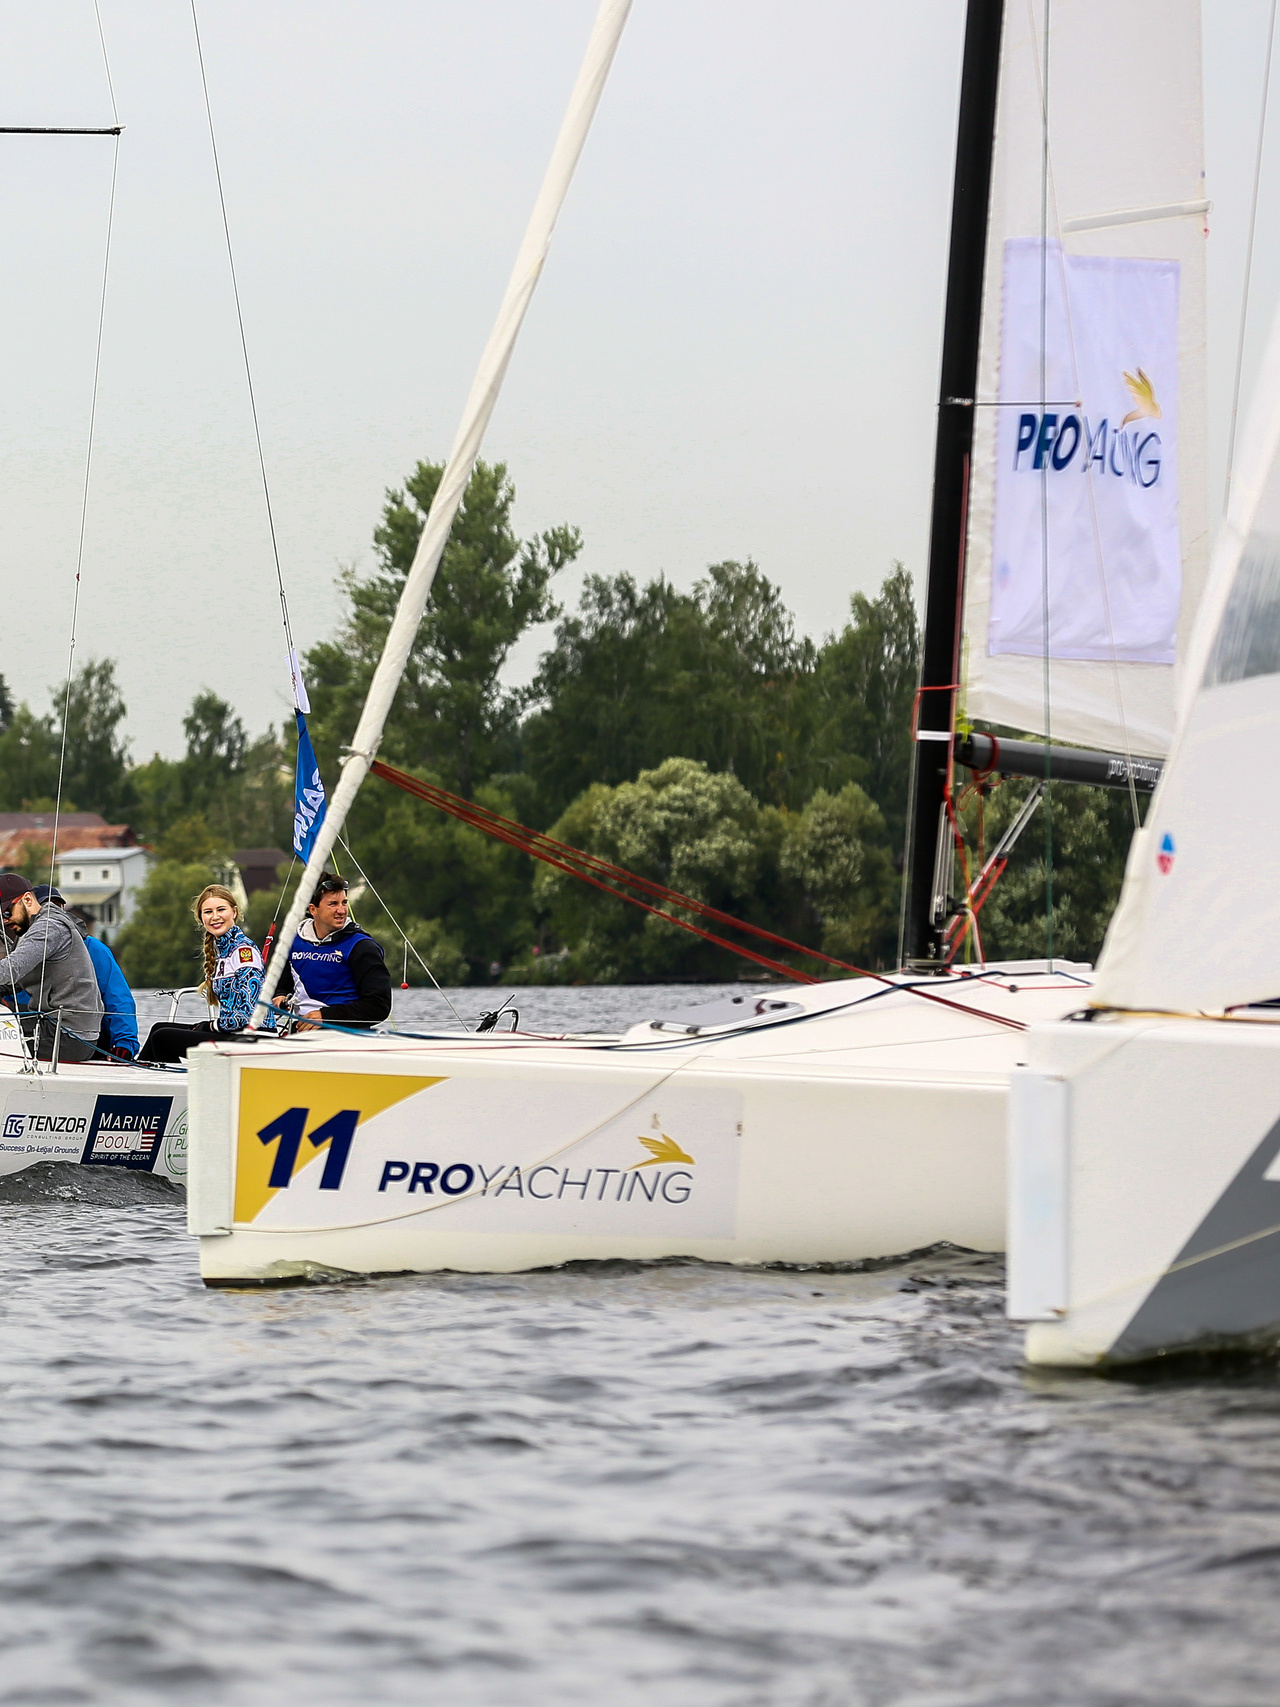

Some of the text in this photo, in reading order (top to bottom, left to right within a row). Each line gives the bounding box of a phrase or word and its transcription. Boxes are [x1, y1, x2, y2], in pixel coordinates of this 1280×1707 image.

[292, 951, 343, 963] ROYACHTING
[28, 1115, 87, 1133] TENZOR
[99, 1113, 161, 1129] MARINE
[0, 1143, 80, 1155] Success On Legal Grounds
[95, 1136, 130, 1148] POOL
[256, 1107, 361, 1191] 11
[378, 1160, 695, 1204] PROYACHTING
